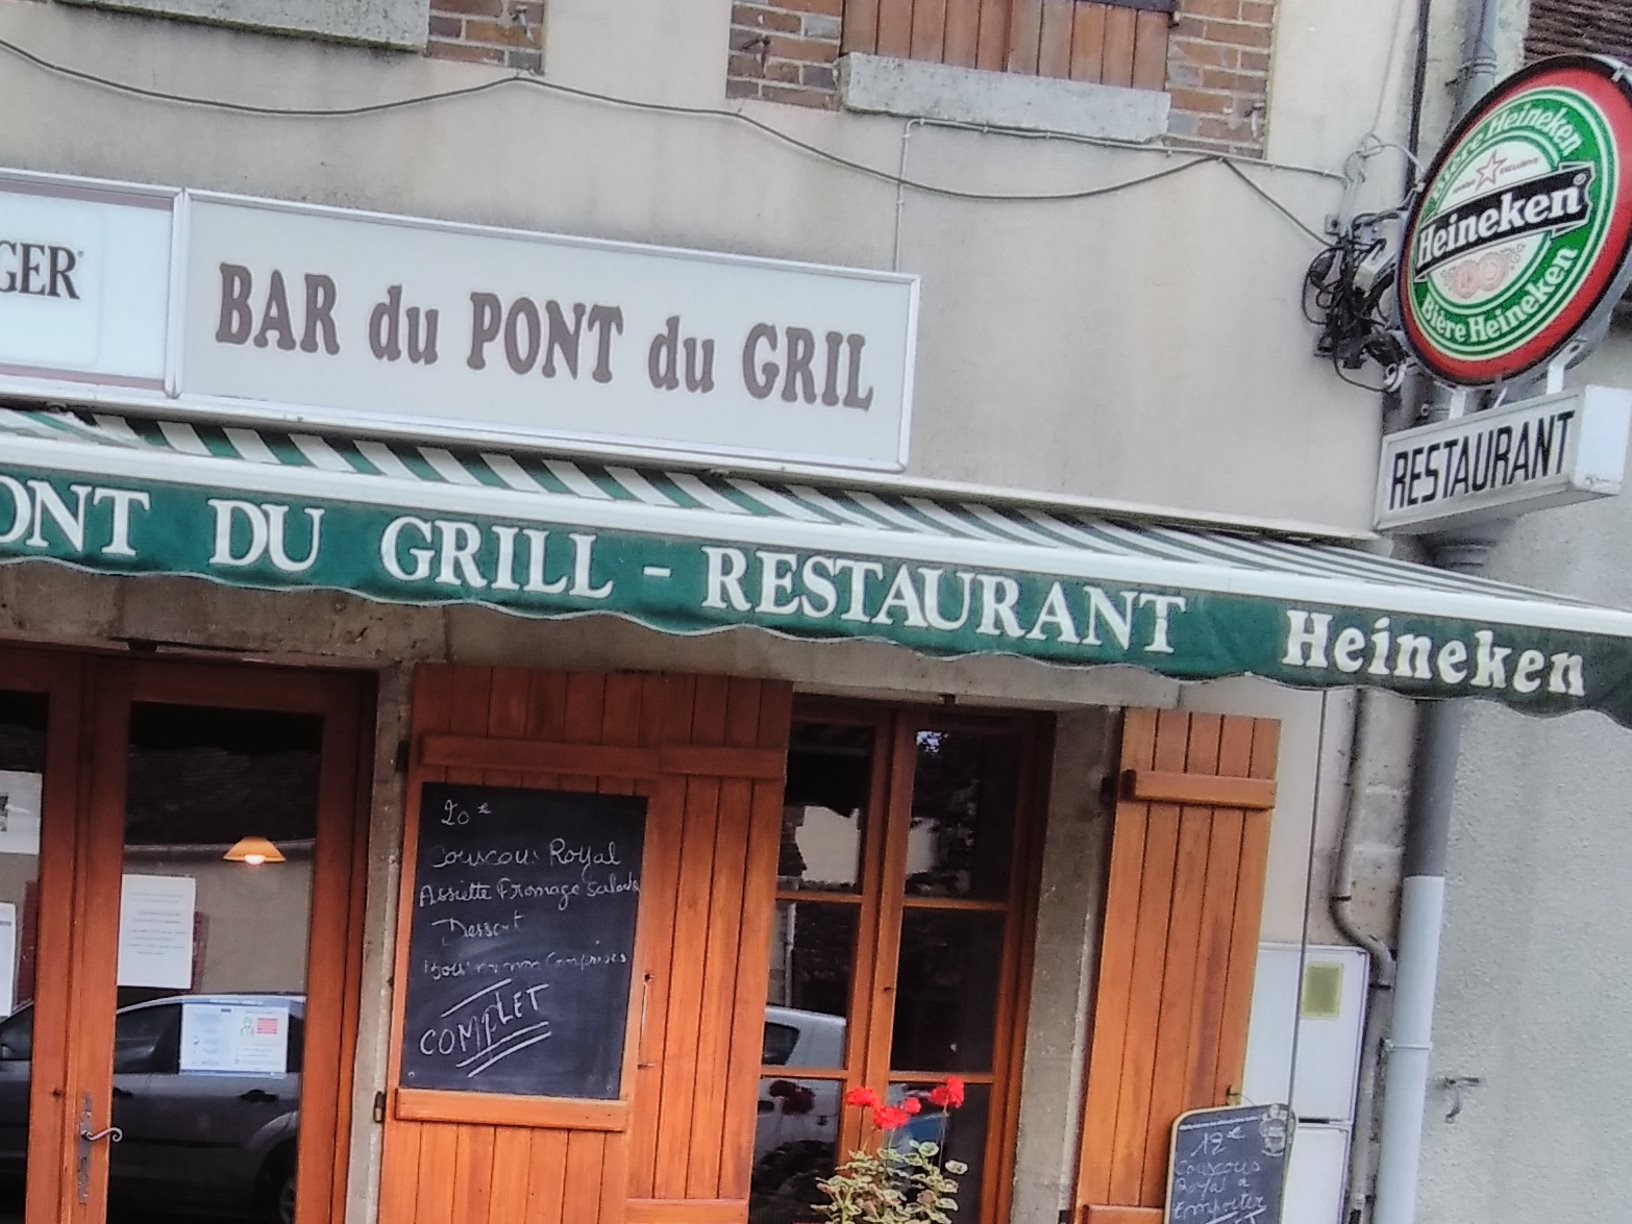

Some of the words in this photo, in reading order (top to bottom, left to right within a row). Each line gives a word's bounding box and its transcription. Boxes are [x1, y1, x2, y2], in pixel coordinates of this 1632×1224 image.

[1486, 102, 1584, 157] Heineken
[1418, 186, 1581, 267] Heineken
[215, 262, 340, 355] BAR
[368, 284, 441, 365] du
[467, 291, 624, 383] PONT
[647, 315, 716, 394] du
[742, 322, 874, 411] GRIL
[1421, 294, 1468, 343] Bière
[1467, 248, 1579, 343] Heineken
[1389, 409, 1576, 511] RESTAURANT
[207, 498, 325, 573] DU
[380, 515, 613, 599] GRILL
[701, 544, 1188, 654] RESTAURANT
[1282, 608, 1585, 698] Heineken
[420, 983, 550, 1055] COMPLET
